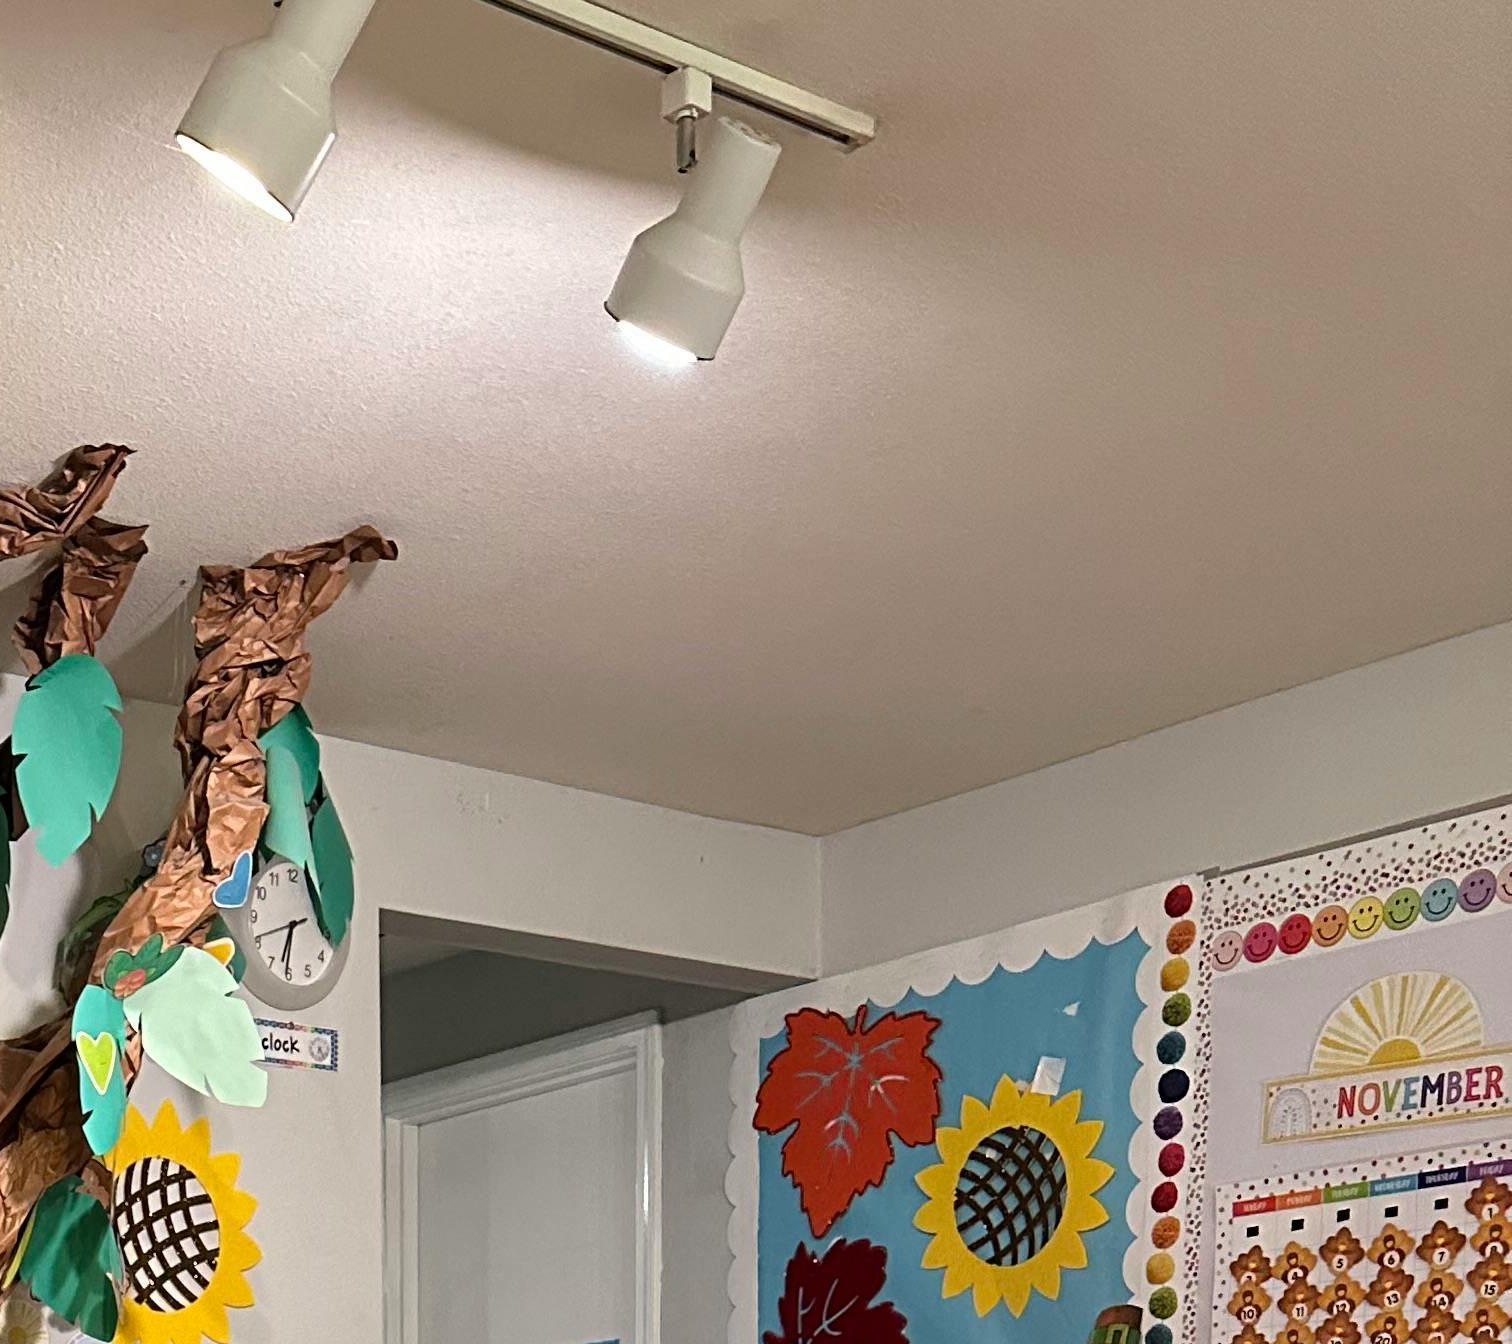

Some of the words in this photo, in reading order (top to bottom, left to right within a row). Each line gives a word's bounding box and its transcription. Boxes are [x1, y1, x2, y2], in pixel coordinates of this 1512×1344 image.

[269, 872, 279, 886] 11
[287, 869, 298, 883] 12
[256, 886, 266, 900] 10
[250, 910, 258, 923] 9
[268, 956, 275, 968] 7
[317, 949, 325, 963] 4
[286, 967, 292, 981] 6
[304, 964, 312, 978] 5
[261, 1032, 300, 1054] clock
[1337, 1065, 1504, 1119] NOVEMBER
[1487, 1207, 1493, 1219] 1
[1336, 1259, 1344, 1269] 5
[1388, 1253, 1395, 1265] 6
[1438, 1251, 1446, 1263] 7
[1243, 1309, 1255, 1319] 10
[1296, 1307, 1304, 1317] 11
[1386, 1293, 1399, 1305] 13
[1432, 1298, 1446, 1309] 14
[1483, 1284, 1496, 1296] 15
